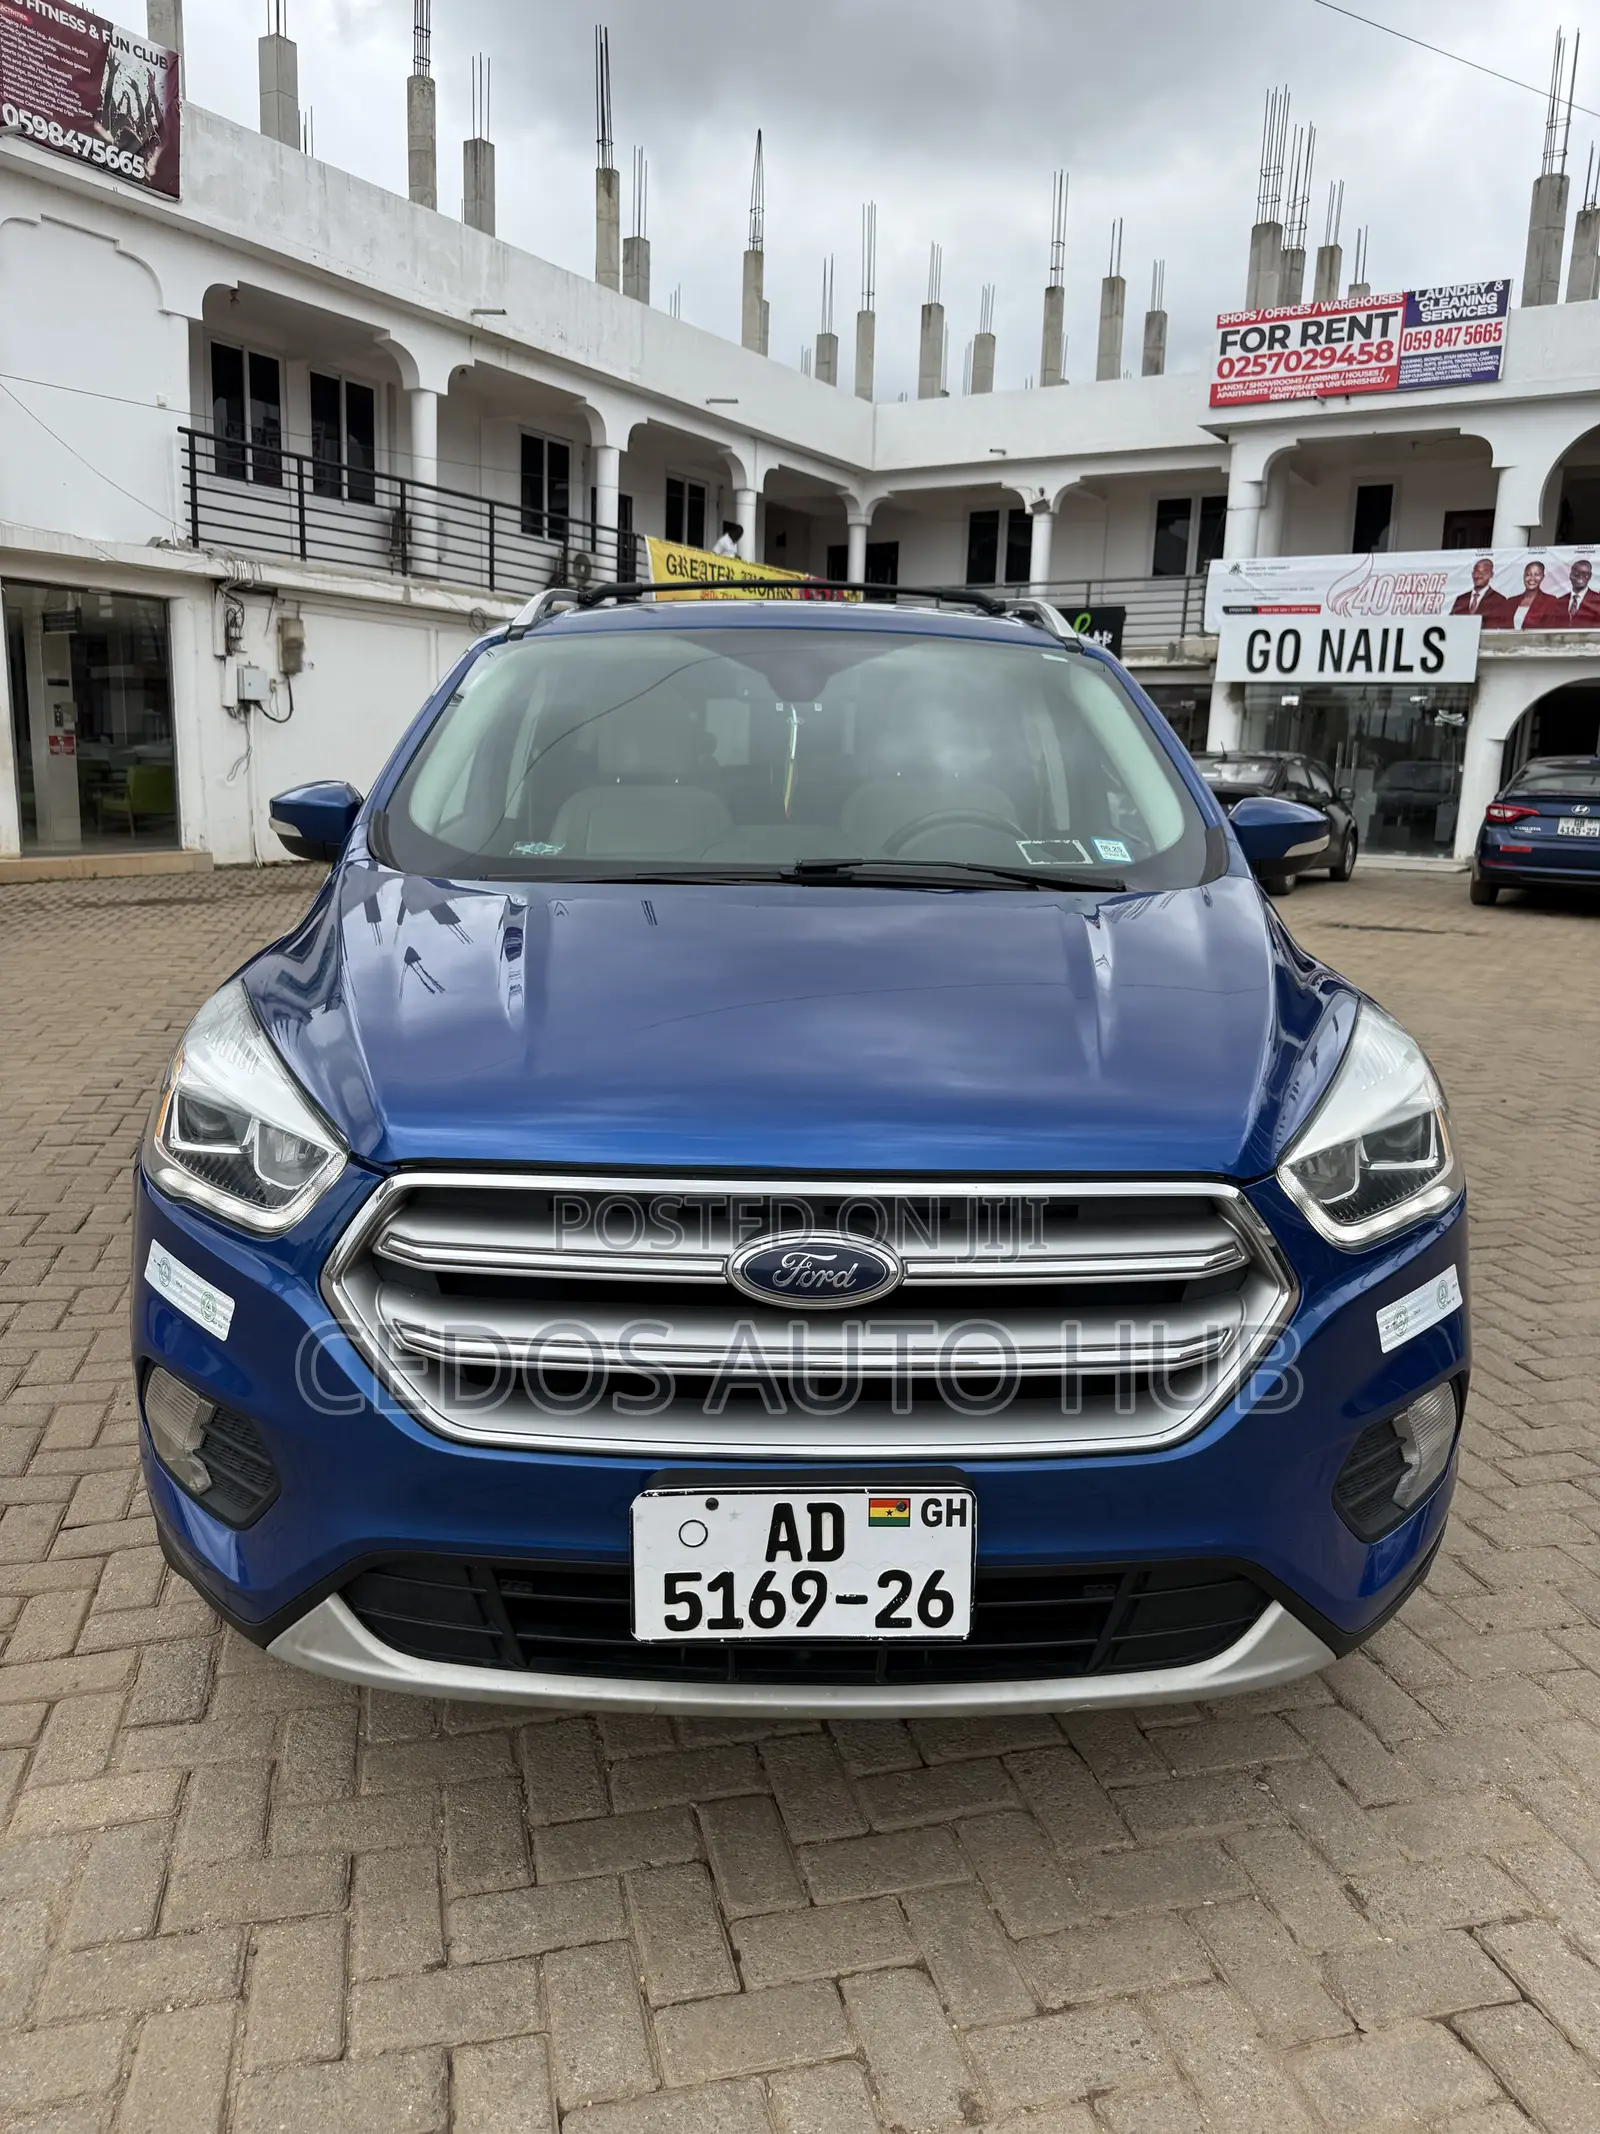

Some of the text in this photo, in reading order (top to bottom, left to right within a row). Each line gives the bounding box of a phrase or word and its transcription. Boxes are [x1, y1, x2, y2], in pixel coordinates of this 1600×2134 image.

[27, 0, 169, 70] FITNESS & FUN CLUB
[2, 102, 146, 179] 0598475665
[1414, 280, 1504, 302] LAUNDRY &
[1418, 292, 1498, 312] CLEANING
[1219, 310, 1256, 325] SHOPS
[1265, 304, 1312, 320] OFFICES
[1320, 293, 1404, 312] WAREHOUSES
[1421, 303, 1498, 322] SERVICES
[1219, 310, 1400, 356] FOR RENT
[1404, 322, 1503, 351] 059 847 5665
[1217, 340, 1394, 380] 0257029458
[1216, 383, 1244, 393] LANDS
[1248, 376, 1303, 389] SHOWROOMS
[1308, 372, 1340, 383] AIRBNB
[1345, 368, 1379, 379] HOUSES
[1216, 386, 1268, 400] APARTMENTS
[1325, 376, 1384, 389] UNFURNISHED
[1268, 392, 1290, 401] RENT
[666, 553, 735, 582] GREATER
[1352, 575, 1395, 616] 40
[1394, 574, 1448, 594] DAYS OF
[1392, 593, 1446, 616] POWER
[1246, 626, 1446, 674] GO NAILS
[772, 1252, 858, 1289] Ford
[764, 1498, 967, 1563] AD GH
[664, 1569, 954, 1632] 5169-26
